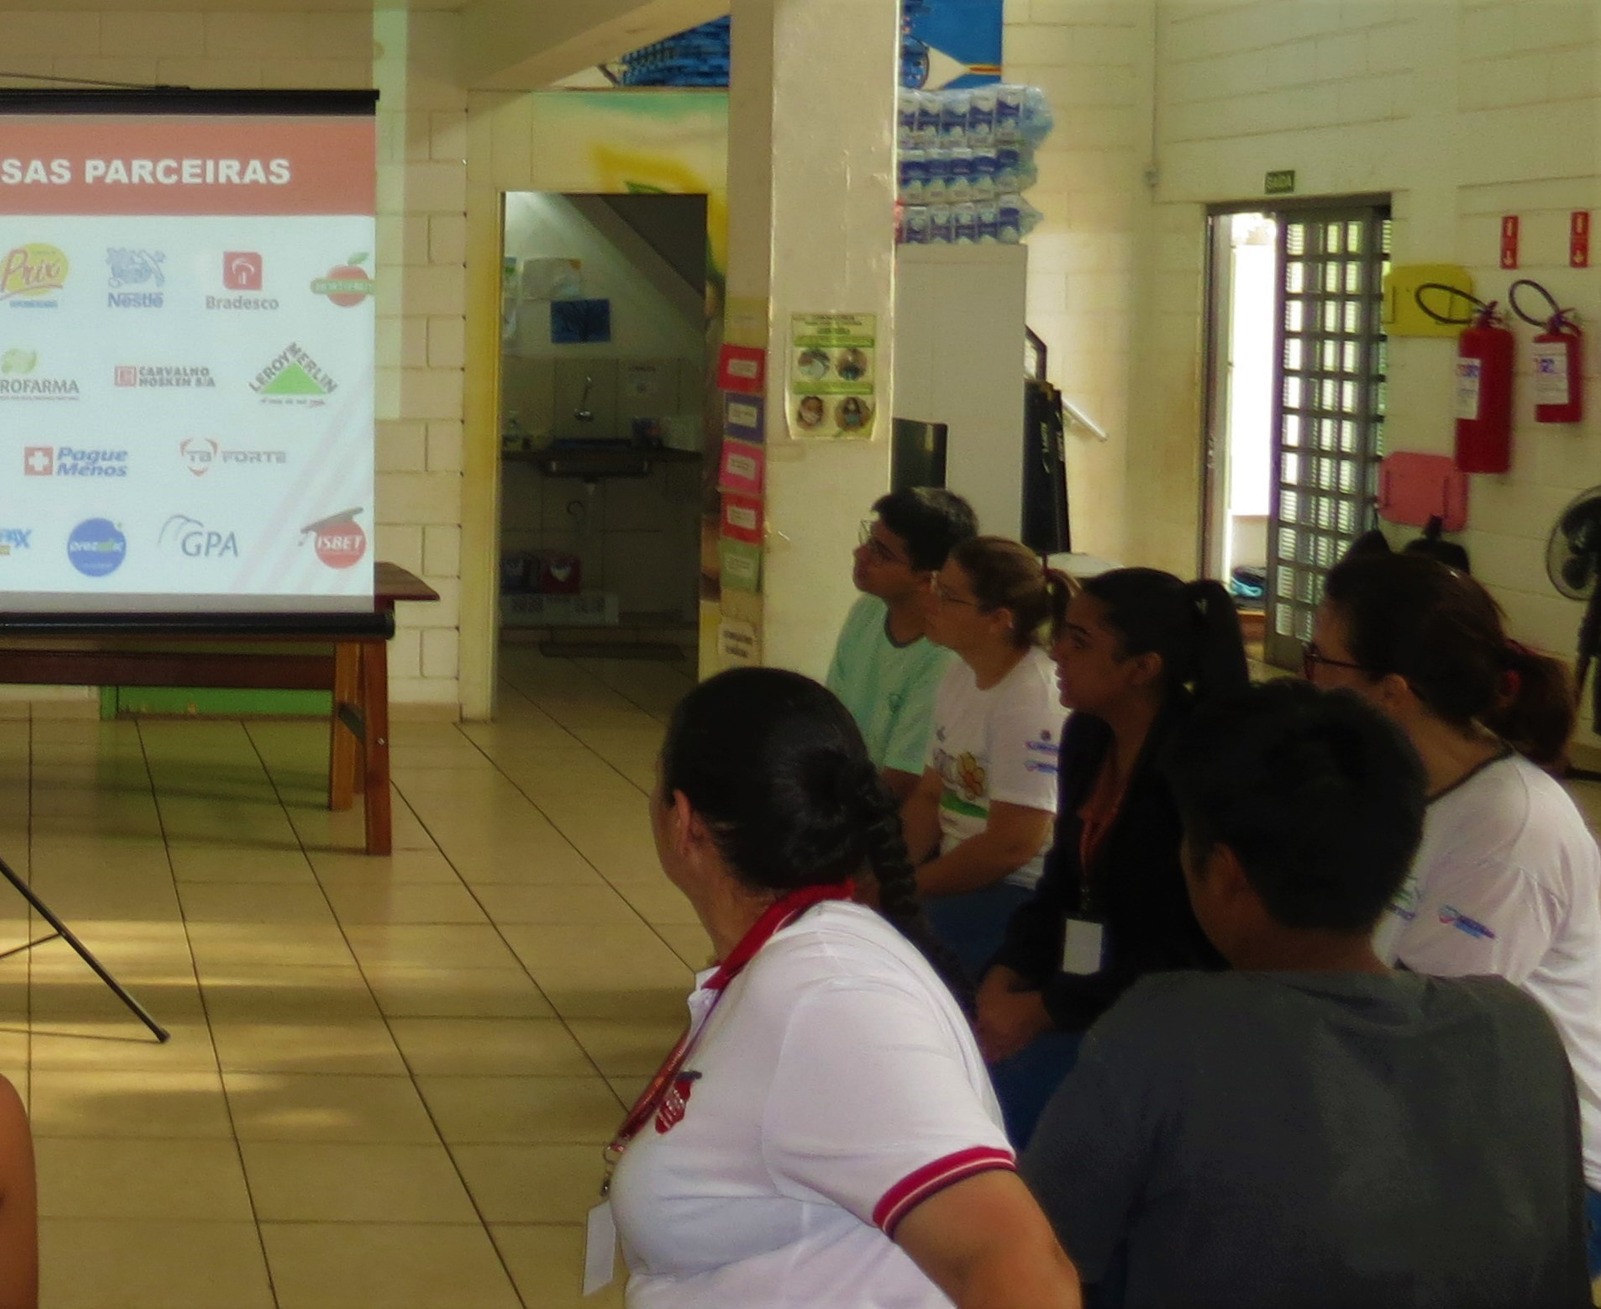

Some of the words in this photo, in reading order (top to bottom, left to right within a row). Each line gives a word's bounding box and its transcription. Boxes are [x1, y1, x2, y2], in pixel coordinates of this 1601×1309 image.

[84, 158, 292, 186] PARCEIRAS
[205, 295, 279, 310] Bradesco
[248, 350, 292, 394] LEROY
[286, 341, 339, 394] MERLIN
[57, 446, 129, 466] Pague
[222, 450, 288, 465] FORTE
[57, 463, 128, 478] Menos
[181, 531, 240, 558] GPA
[317, 535, 362, 552] ISBET
